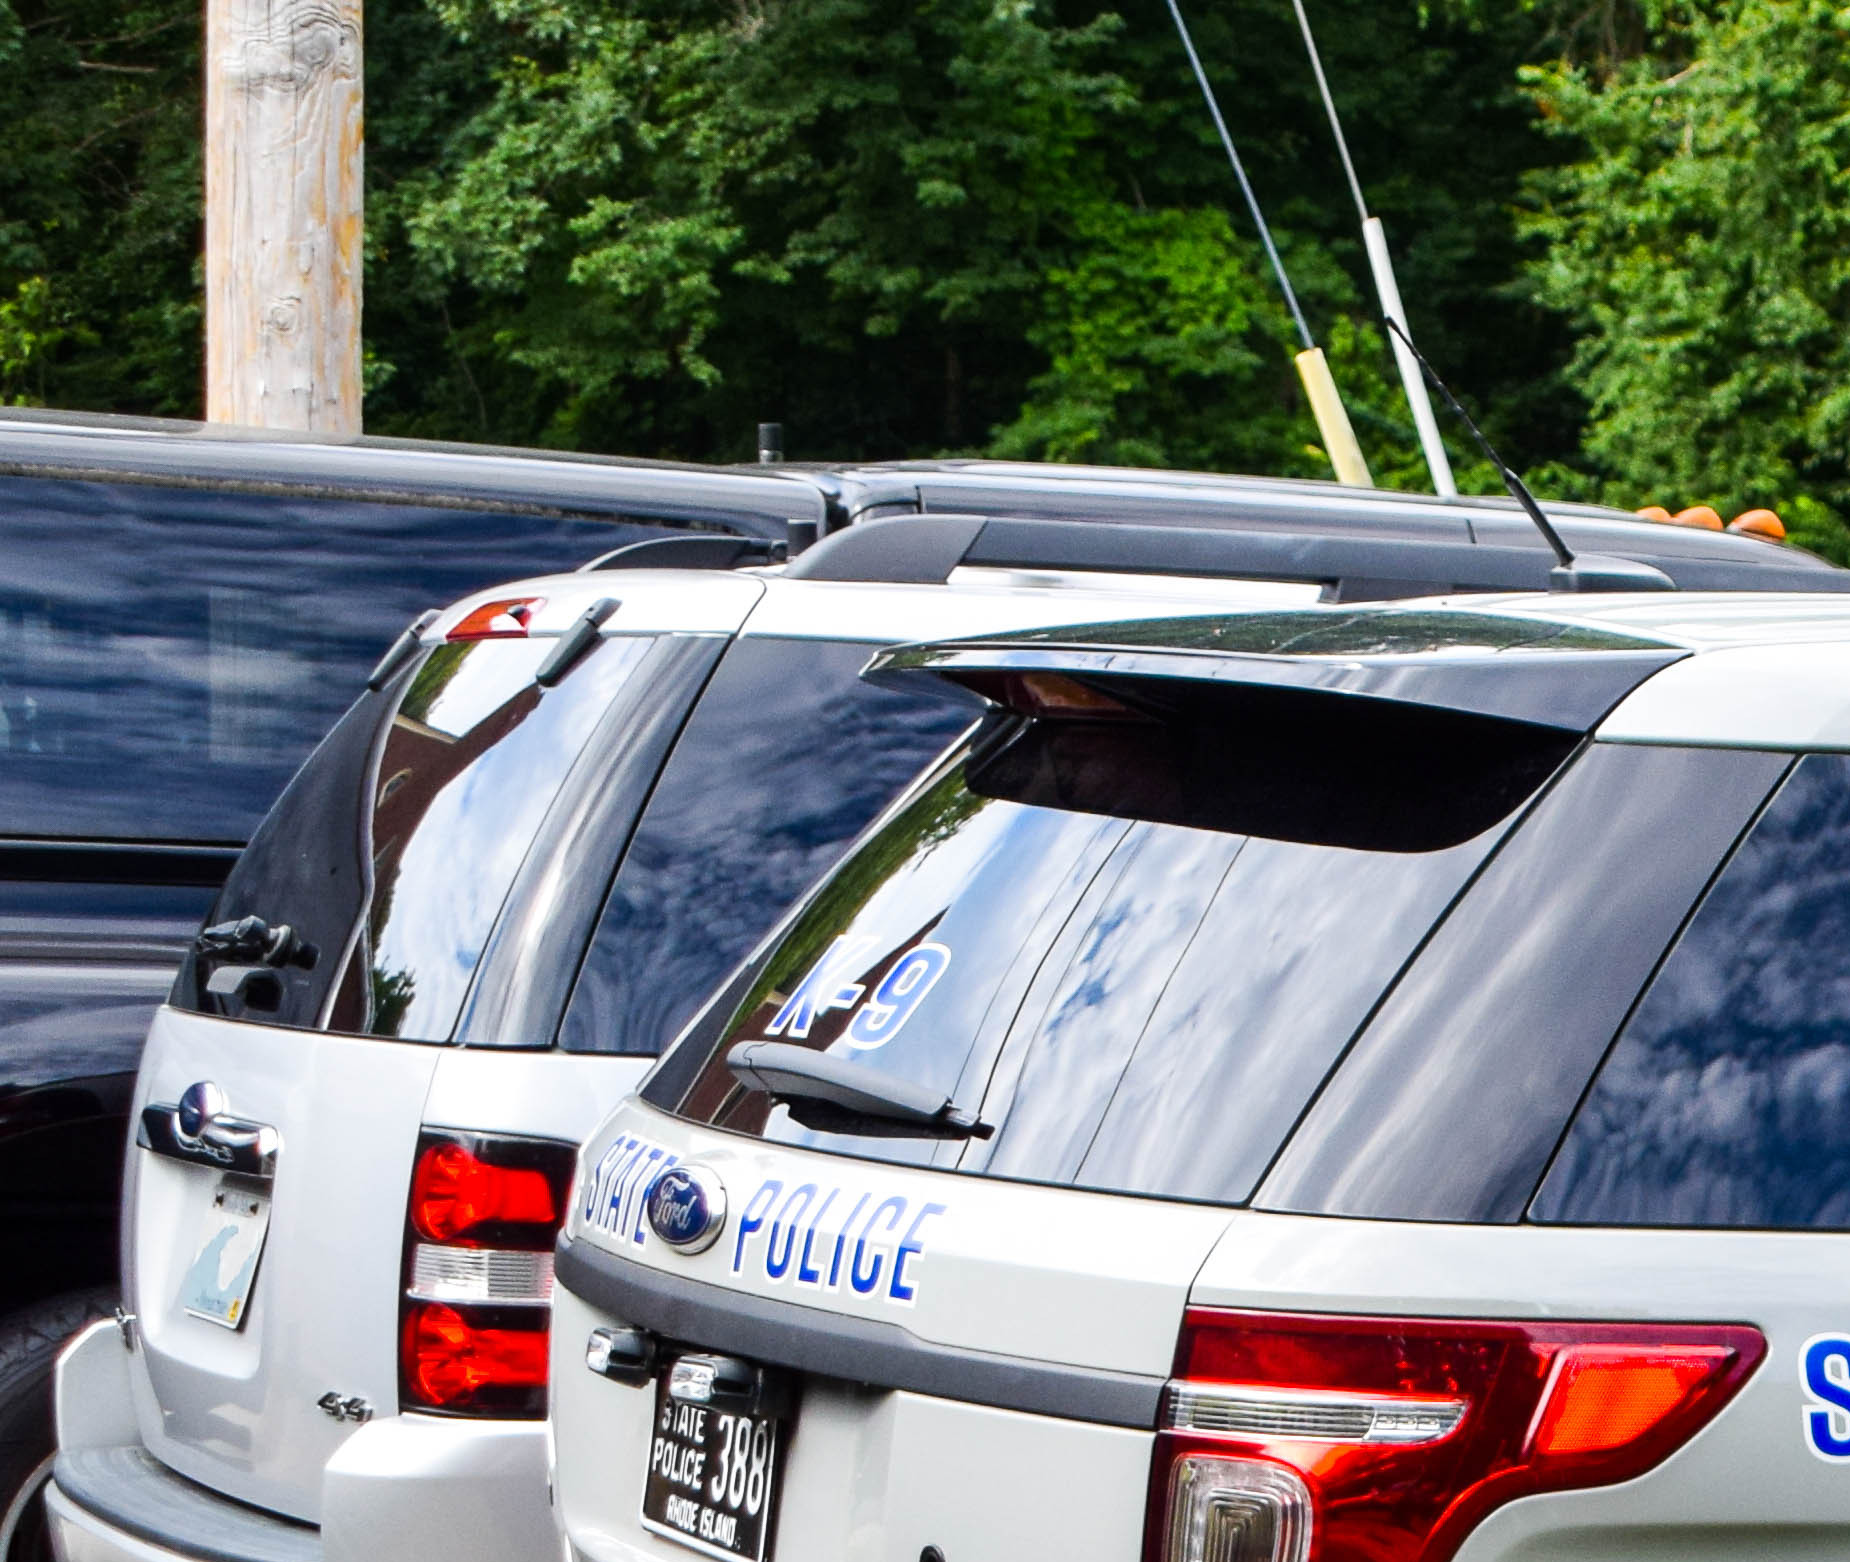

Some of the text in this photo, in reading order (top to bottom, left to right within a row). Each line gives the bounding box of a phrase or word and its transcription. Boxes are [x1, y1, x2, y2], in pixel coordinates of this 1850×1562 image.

[764, 934, 951, 1050] K-9
[653, 1176, 698, 1230] Ford
[732, 1179, 947, 1306] POLICE
[662, 1403, 707, 1444] STATE
[652, 1437, 707, 1490] POLICE
[711, 1414, 768, 1515] 388
[666, 1494, 738, 1547] RHODE ISLAND
